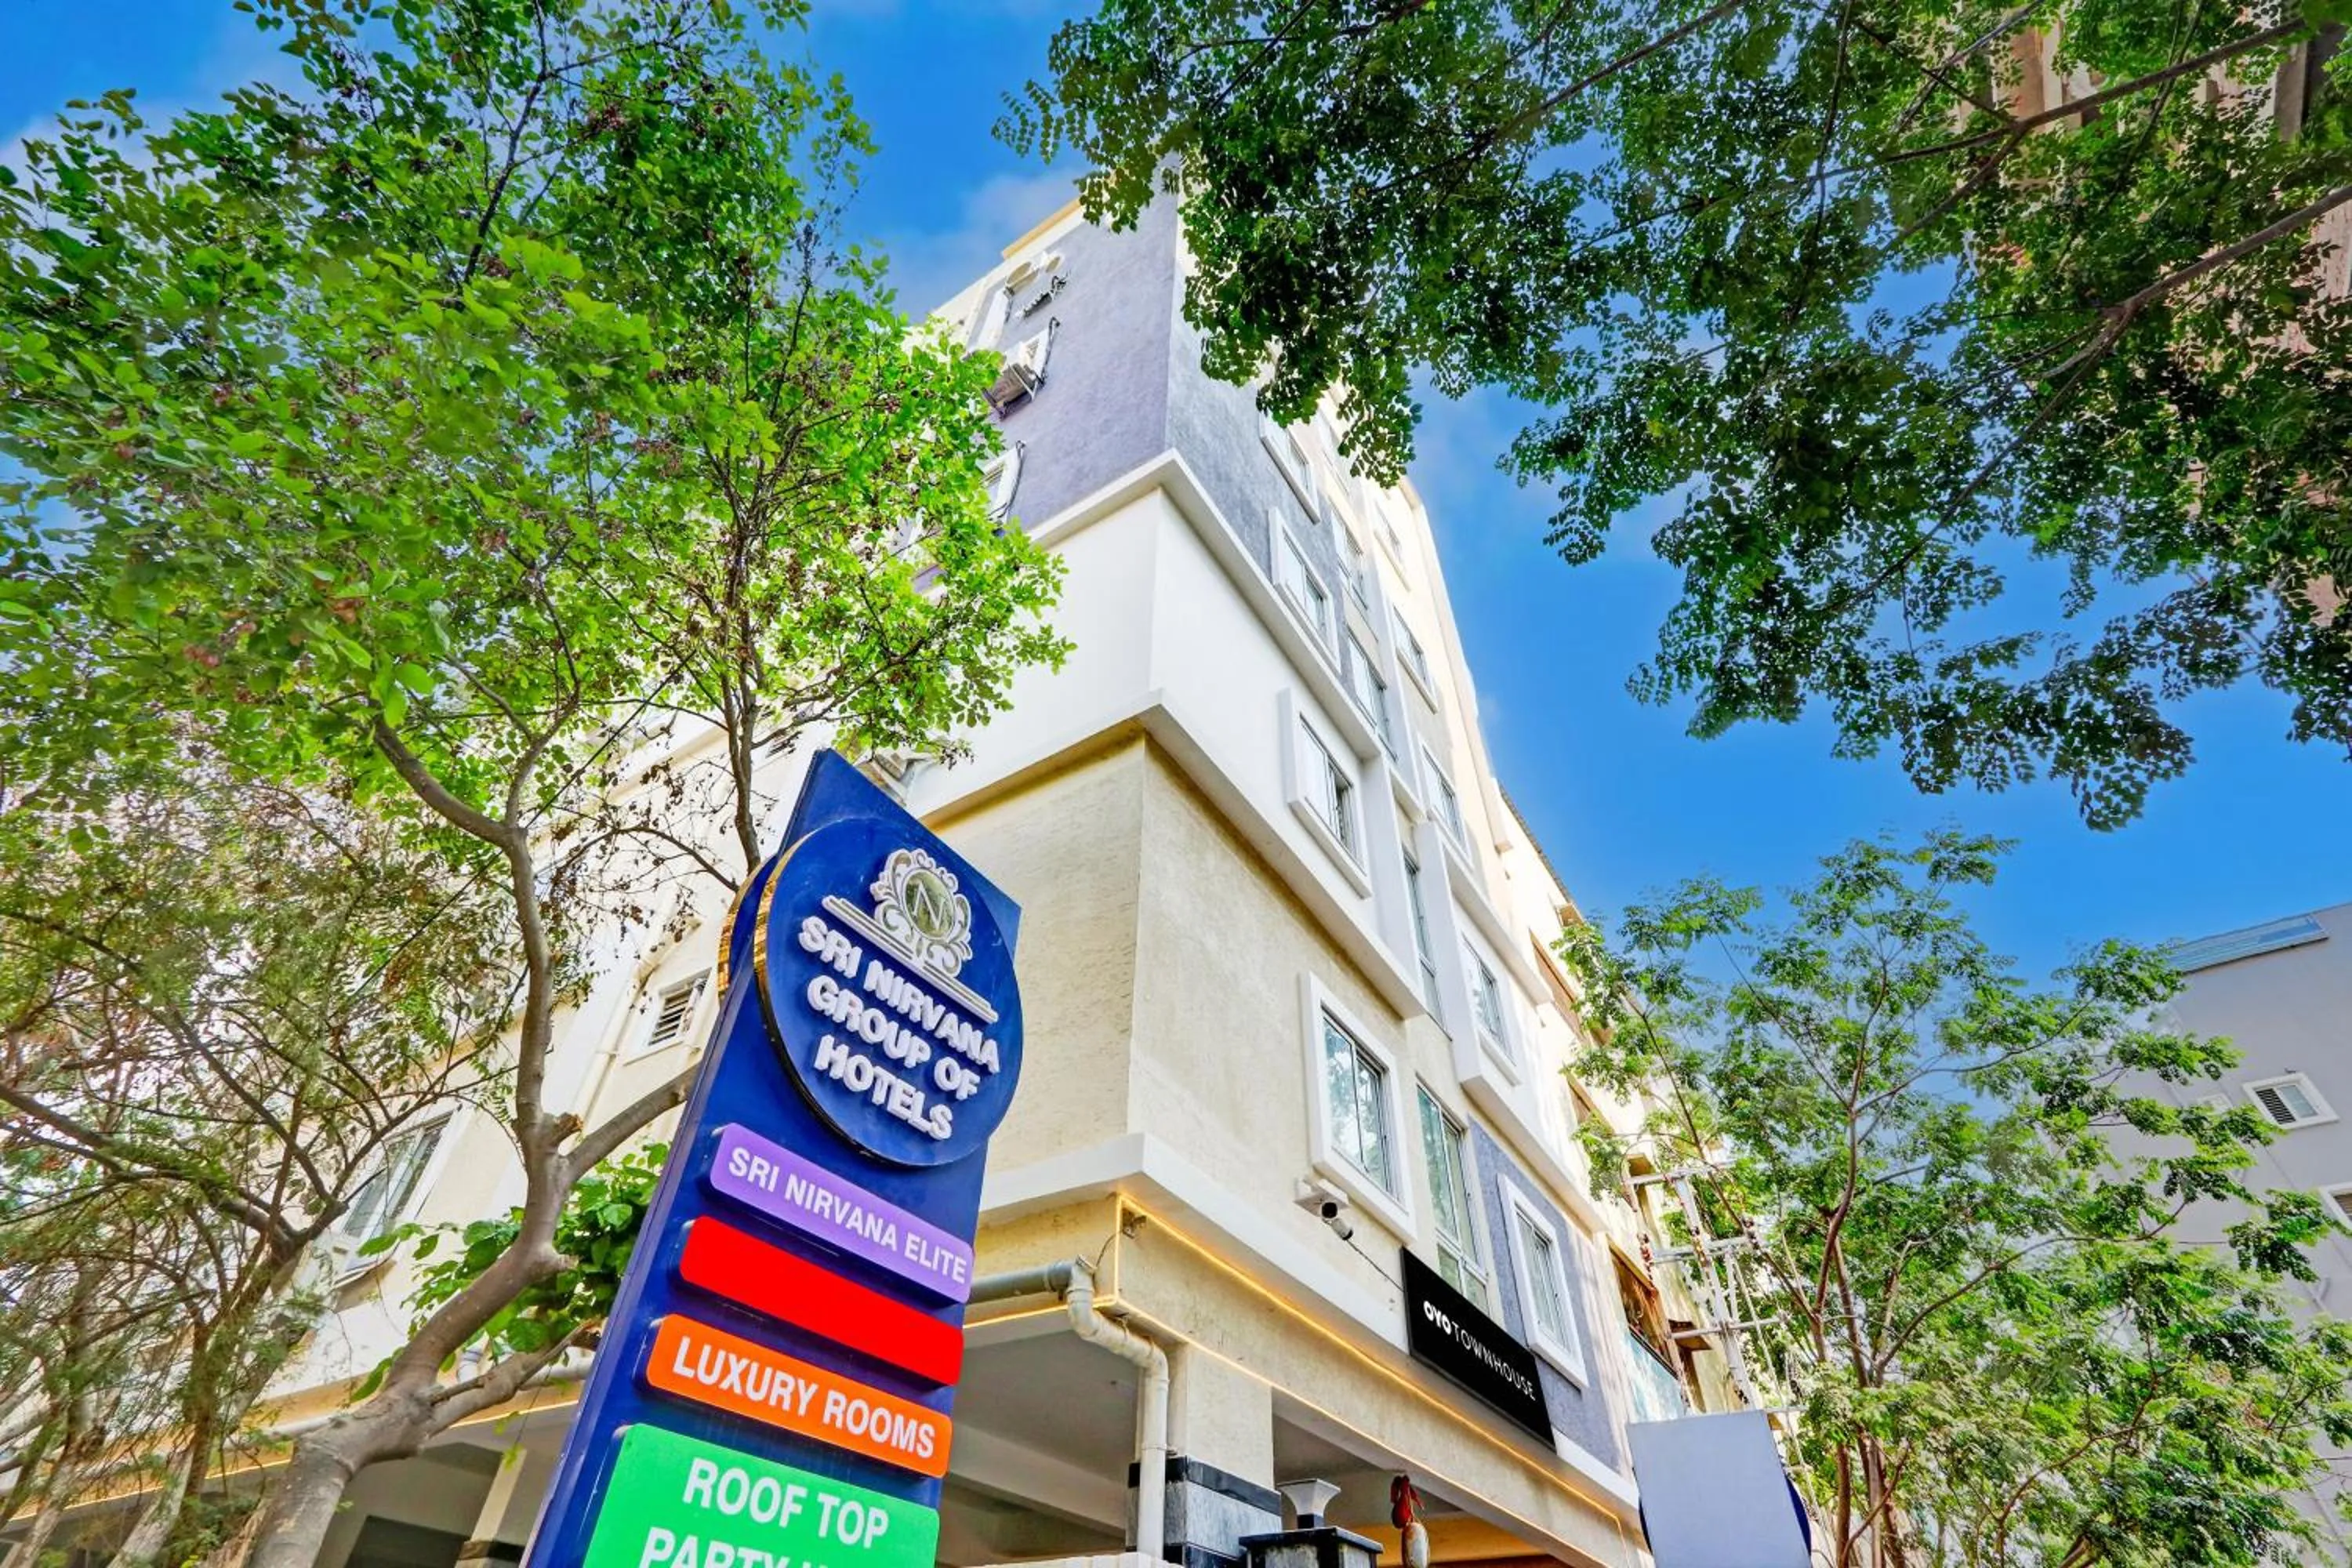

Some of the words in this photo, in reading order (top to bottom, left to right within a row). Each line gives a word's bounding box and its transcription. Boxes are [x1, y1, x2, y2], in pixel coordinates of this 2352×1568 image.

[798, 916, 862, 978] SRI
[863, 960, 1000, 1074] NIRVANA
[807, 975, 931, 1068] GROUP
[934, 1057, 981, 1100] OF
[814, 1035, 953, 1140] HOTELS
[728, 1147, 780, 1192] SRI
[785, 1176, 897, 1251] NIRVANA
[904, 1233, 967, 1283] ELITE
[672, 1336, 818, 1417] LUXURY
[822, 1390, 935, 1459] ROOMS
[1423, 1300, 1451, 1335] OYO
[1451, 1321, 1536, 1401] TOWNHOUSE
[682, 1457, 807, 1528] ROOF
[817, 1492, 889, 1548] TOP
